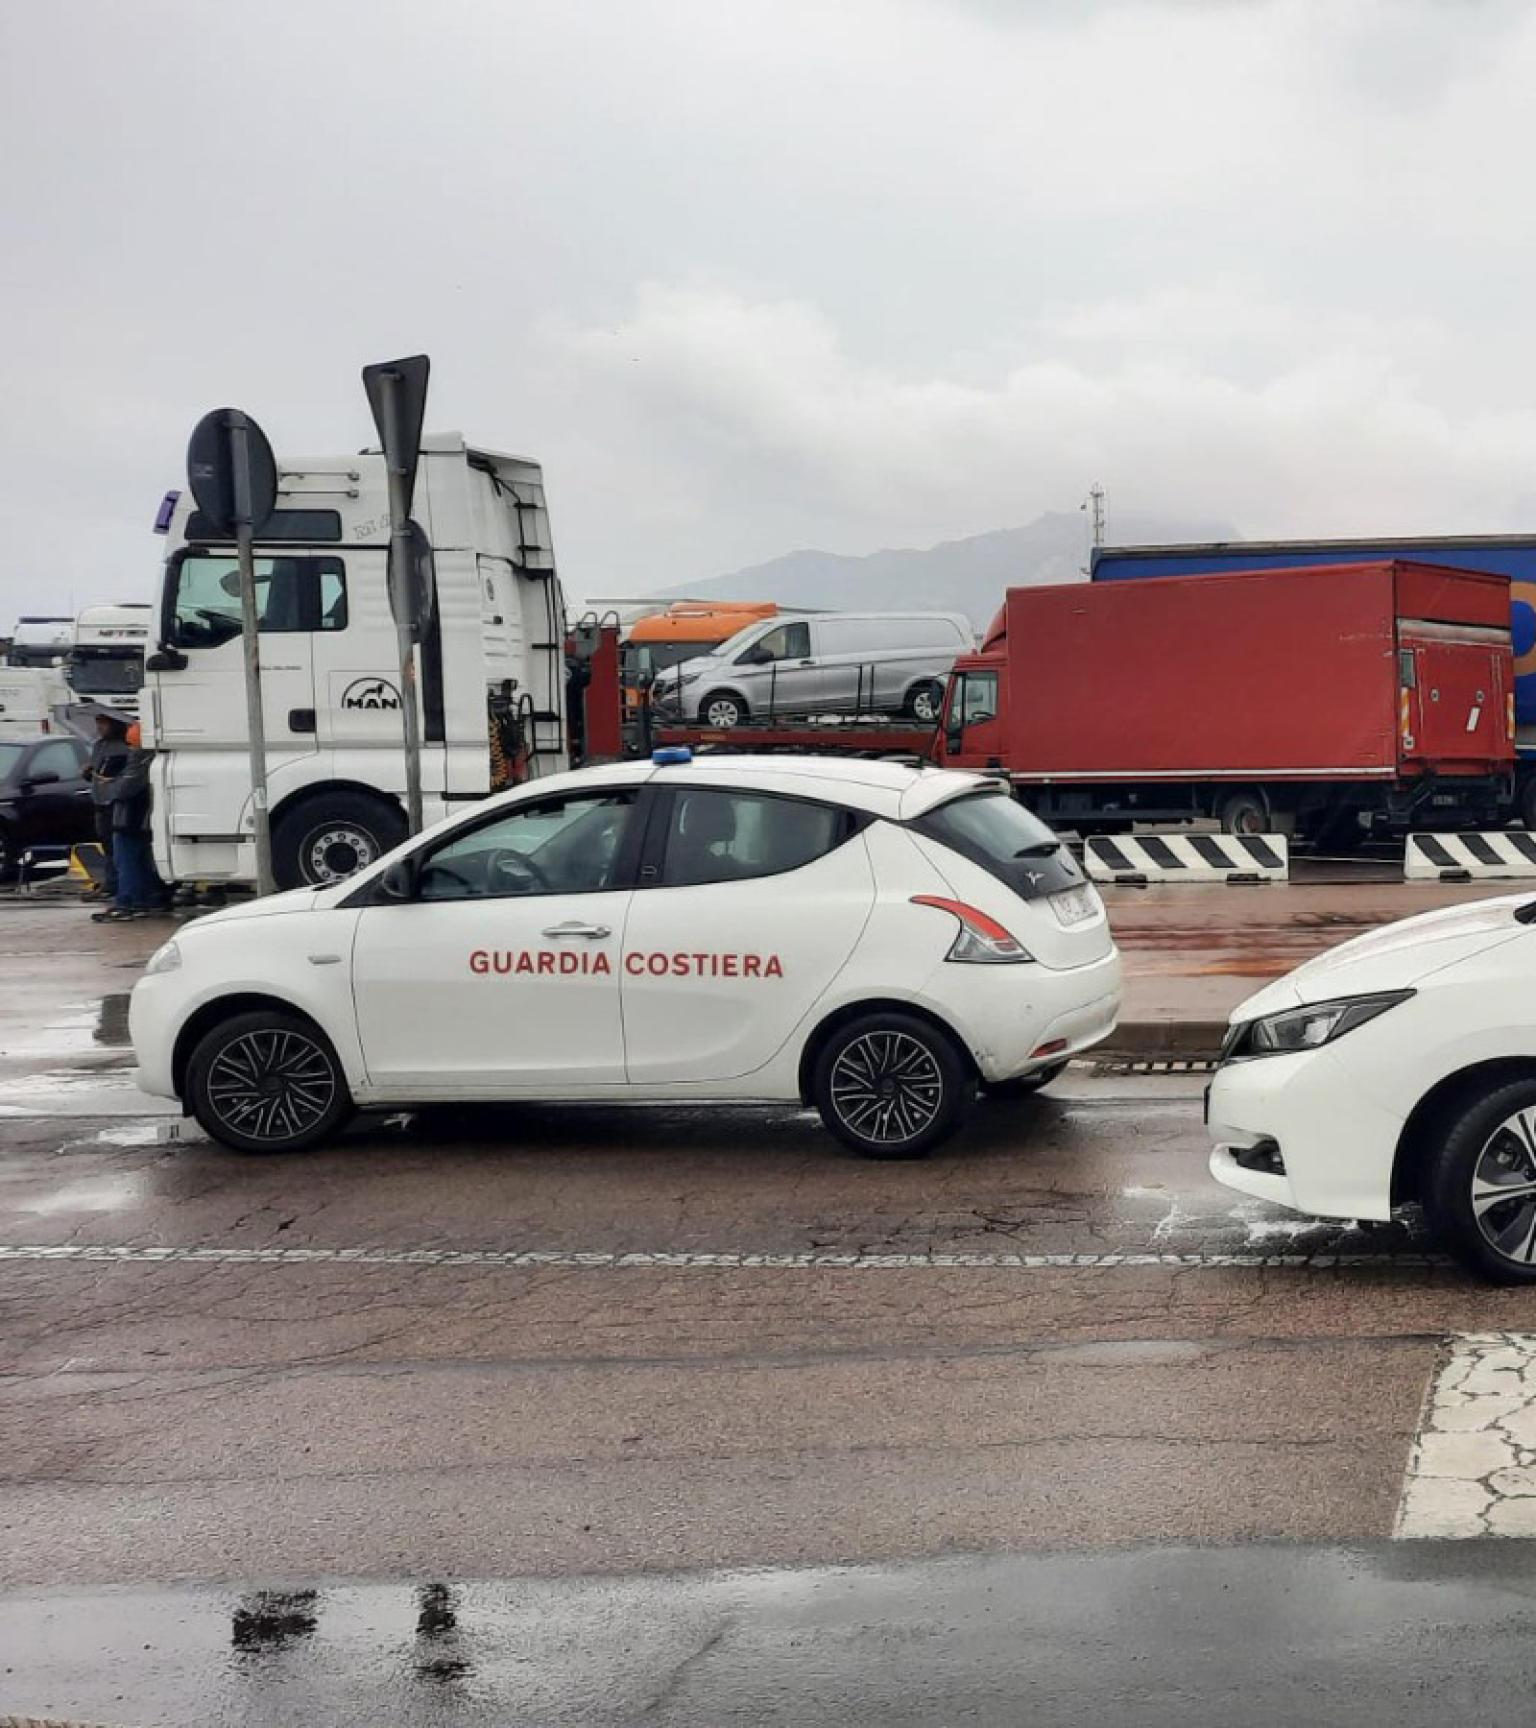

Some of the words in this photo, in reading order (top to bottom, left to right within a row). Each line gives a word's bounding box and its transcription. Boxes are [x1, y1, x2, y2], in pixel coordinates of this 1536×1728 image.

[347, 698, 398, 709] MAN
[469, 950, 611, 975] GUARDIA
[625, 952, 784, 978] COSTIERA
